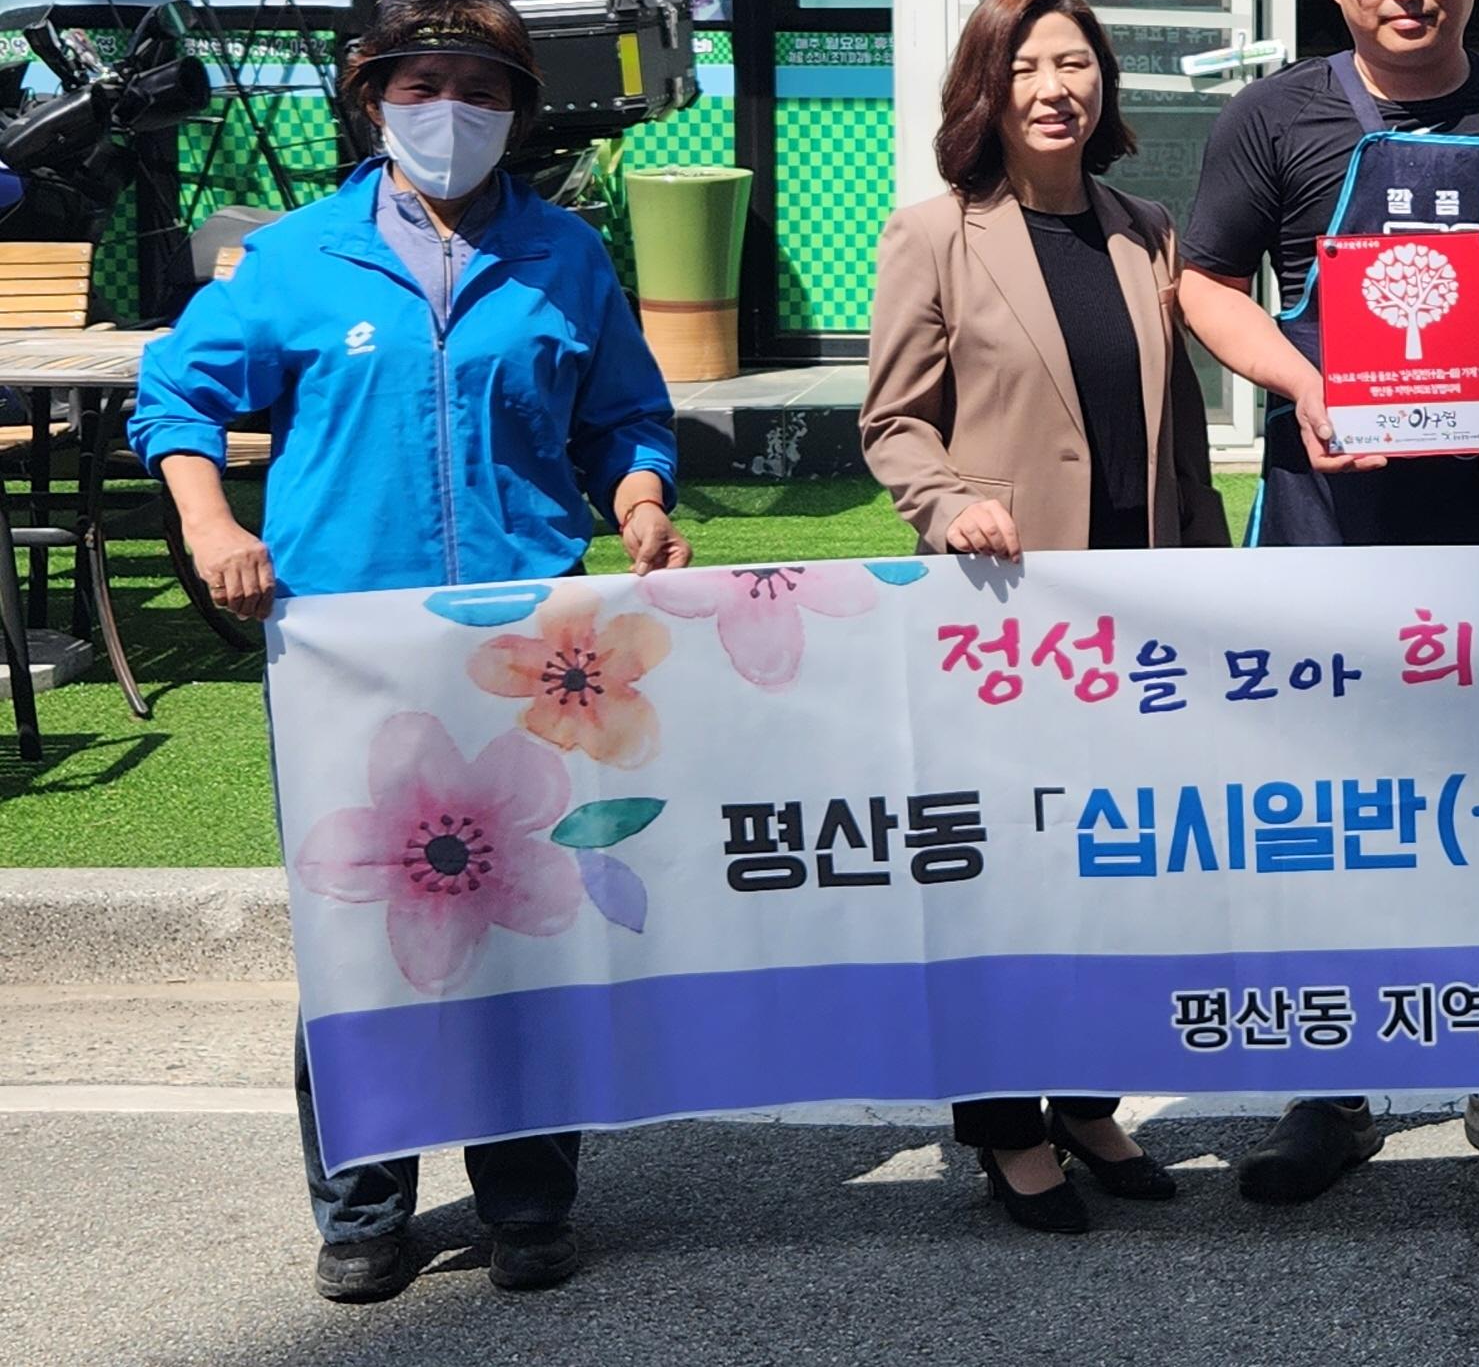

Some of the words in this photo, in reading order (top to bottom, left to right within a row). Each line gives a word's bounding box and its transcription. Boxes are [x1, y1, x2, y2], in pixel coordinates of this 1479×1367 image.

[826, 36, 869, 50] 월요일
[937, 615, 1188, 714] 정성을
[1224, 647, 1362, 701] 모아
[720, 789, 988, 893] 평산동
[1171, 987, 1354, 1050] 평산동
